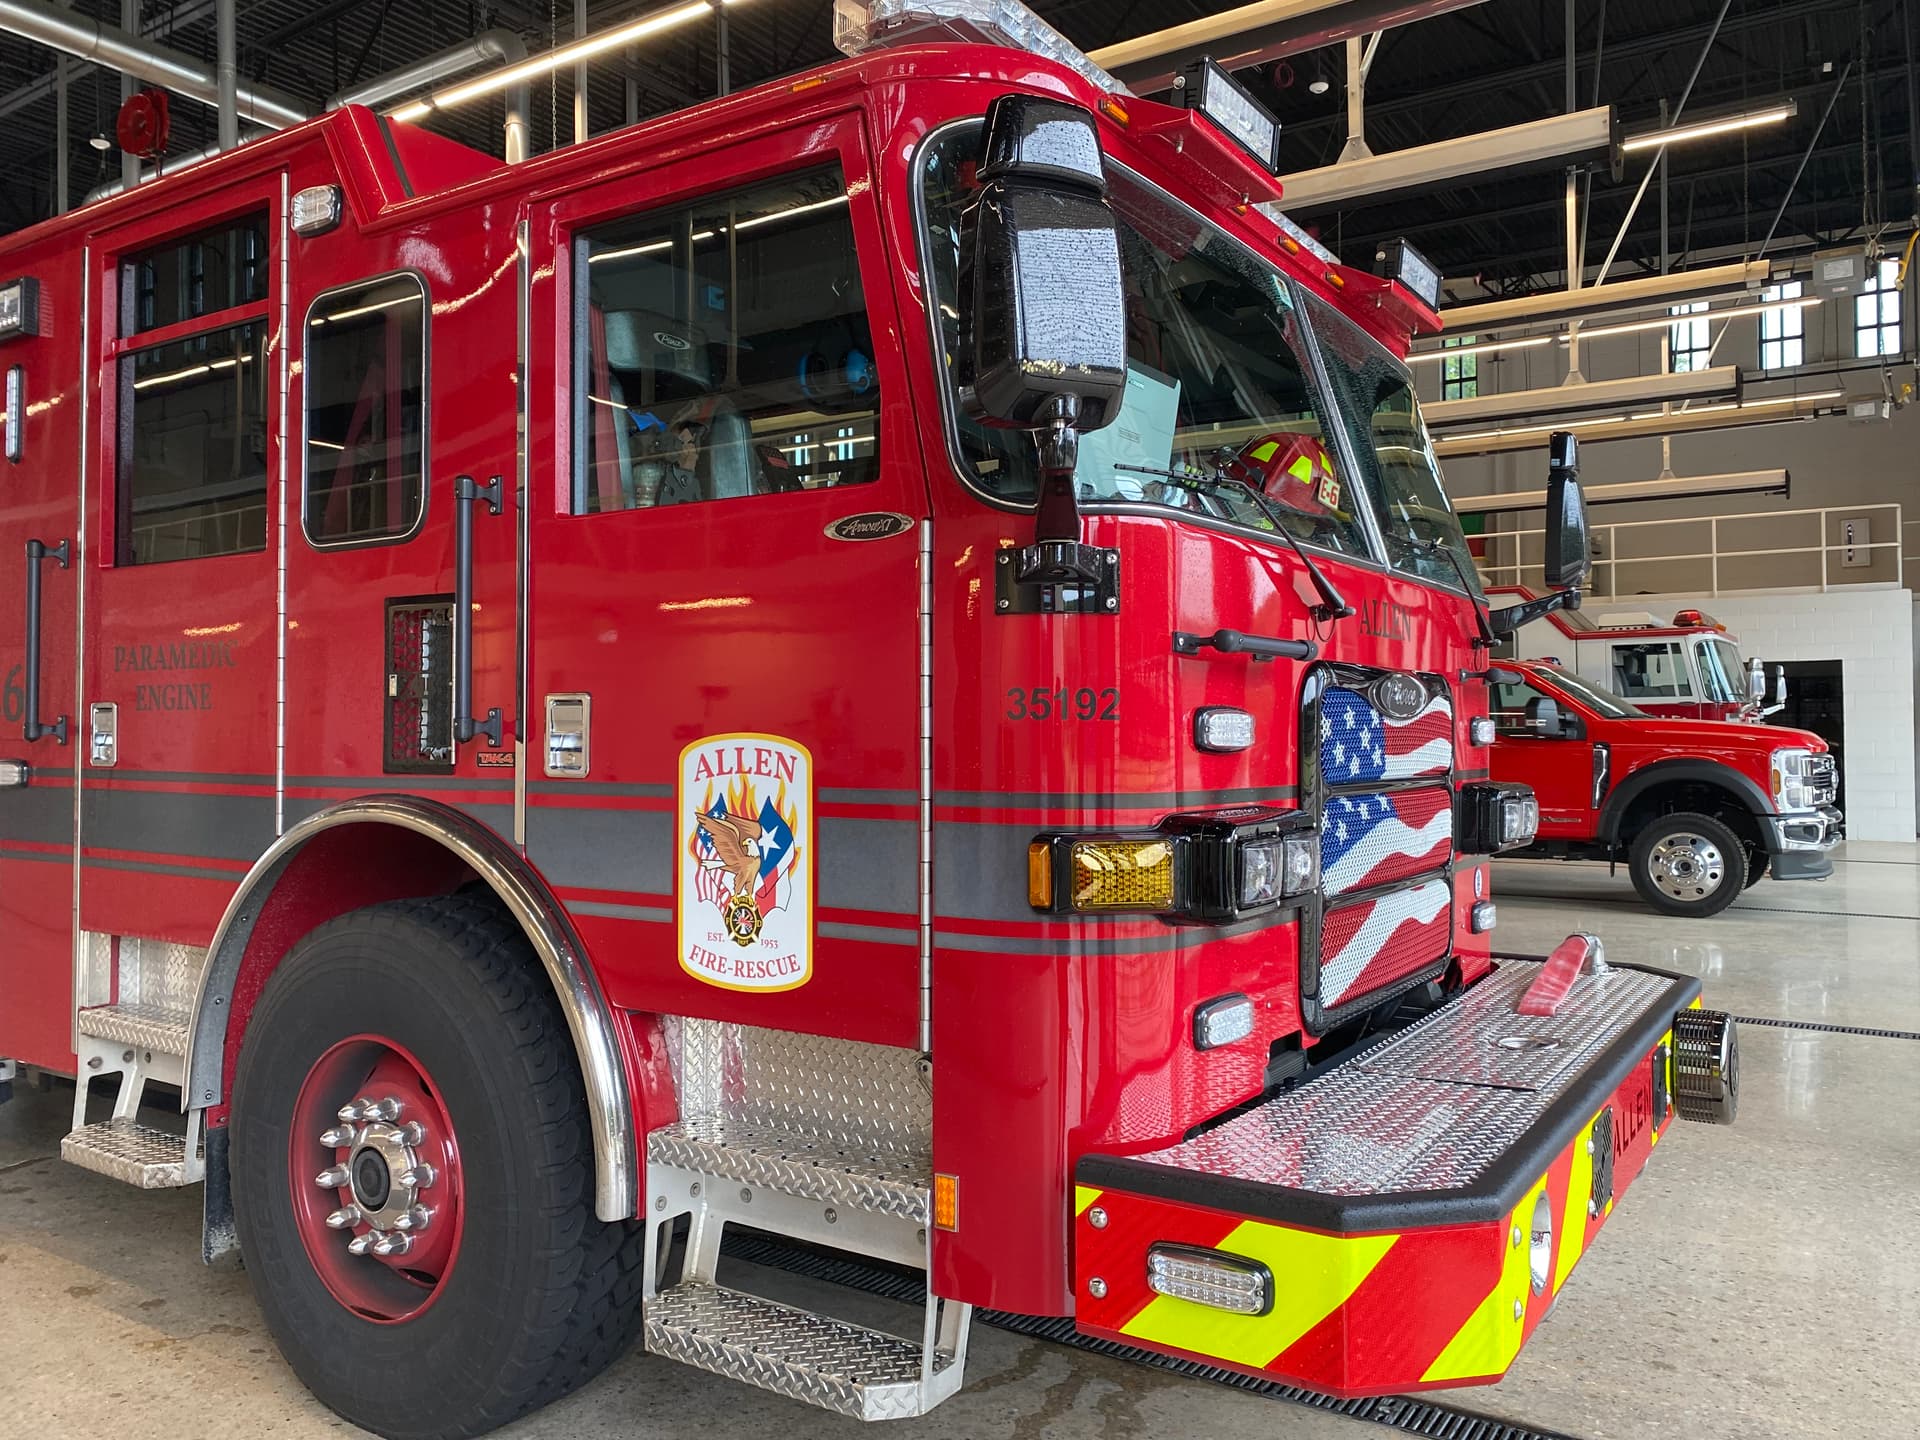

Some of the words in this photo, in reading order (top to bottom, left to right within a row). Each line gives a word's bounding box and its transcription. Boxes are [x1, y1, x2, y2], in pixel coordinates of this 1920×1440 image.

[1320, 478, 1338, 505] E-6
[1360, 597, 1412, 641] ALLEN
[114, 639, 238, 672] PARAMEDIC
[136, 683, 212, 712] ENGINE
[1007, 687, 1120, 721] 35192
[694, 747, 798, 784] ALLEN
[707, 931, 725, 943] EST.
[760, 938, 779, 949] 1953
[688, 944, 801, 979] FIRE-RESCUE
[1612, 1078, 1652, 1167] ALLEN
